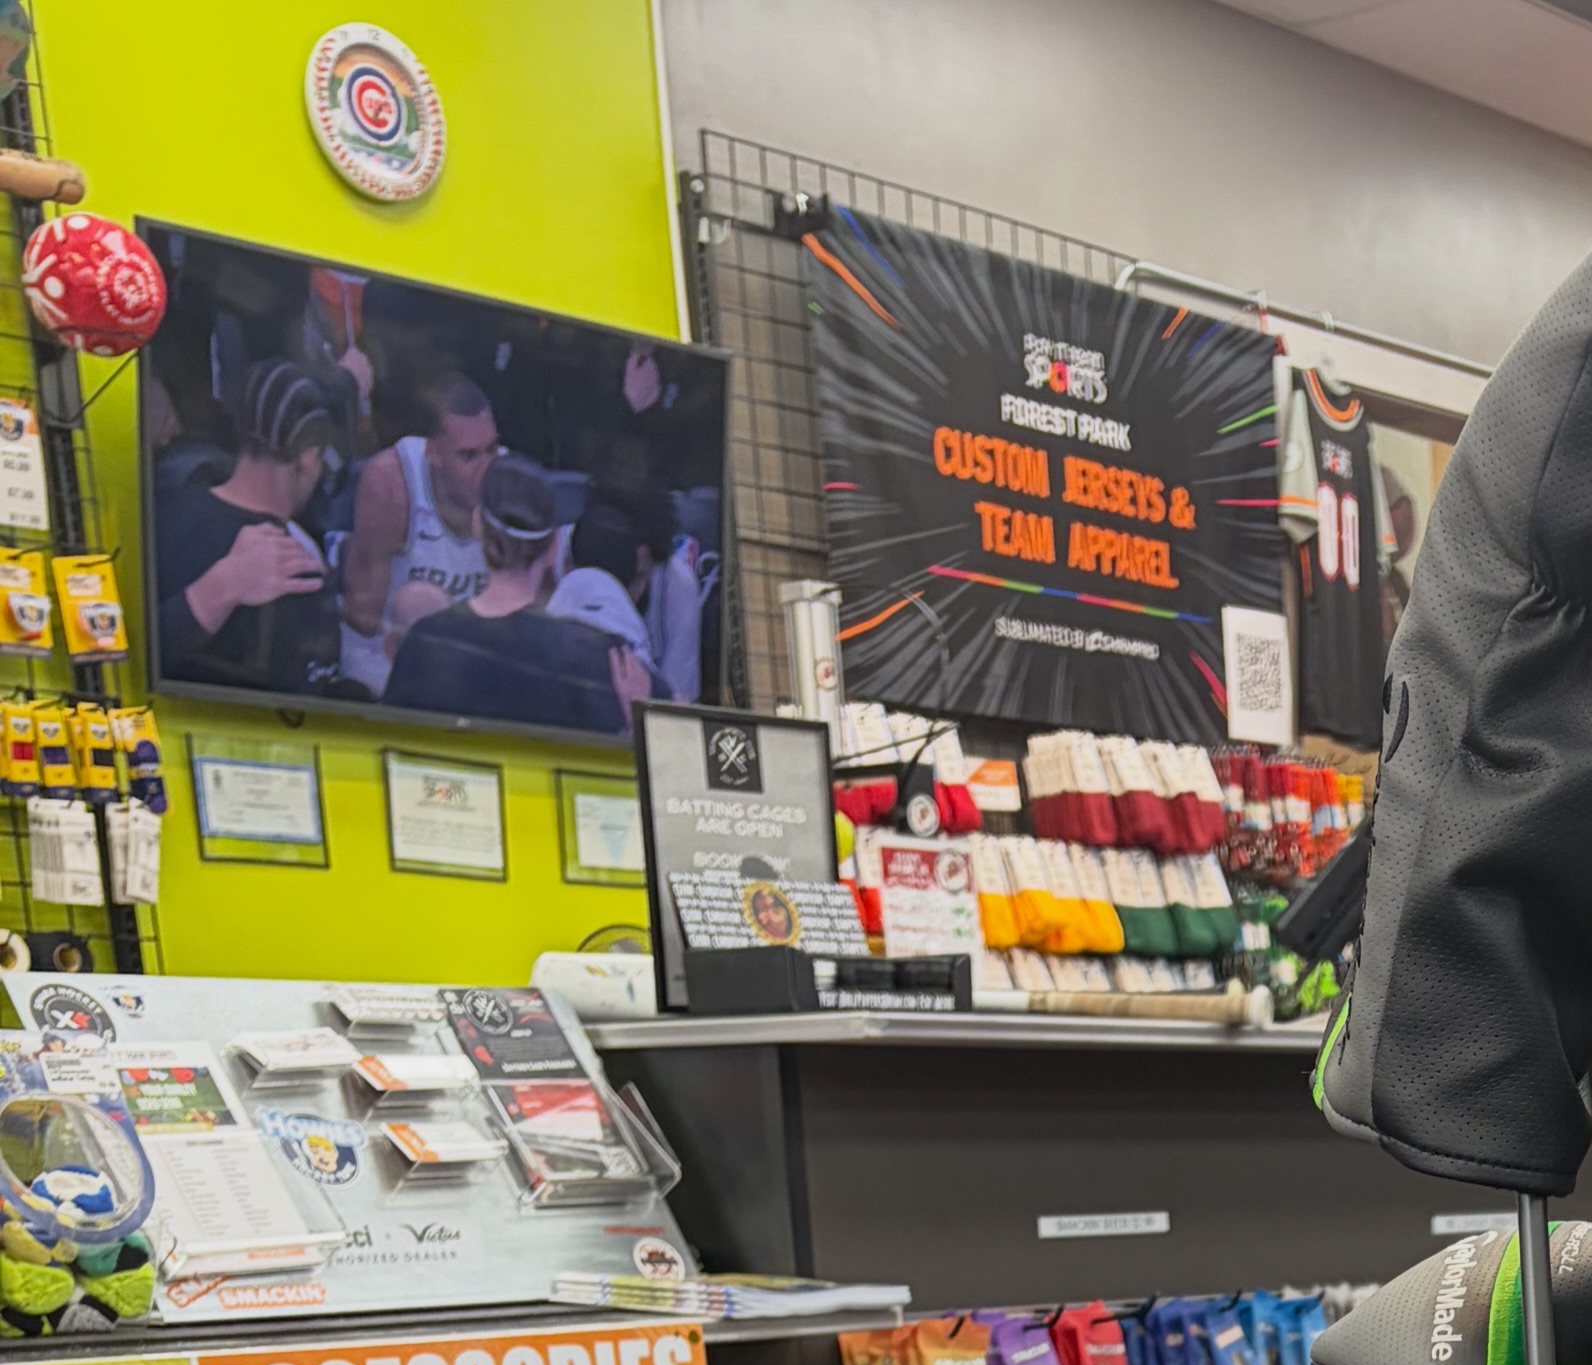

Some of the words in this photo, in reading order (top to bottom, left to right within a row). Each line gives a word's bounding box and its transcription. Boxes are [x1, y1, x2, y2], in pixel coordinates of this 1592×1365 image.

[1000, 393, 1078, 438] FOREST
[1078, 413, 1132, 451] PARK
[933, 426, 1050, 498] CUSTOM
[1062, 455, 1167, 523] JERSEYS
[1169, 486, 1196, 530] &
[974, 501, 1056, 564] TEAM
[1067, 521, 1180, 589] APPAREL
[734, 820, 784, 838] OPEN
